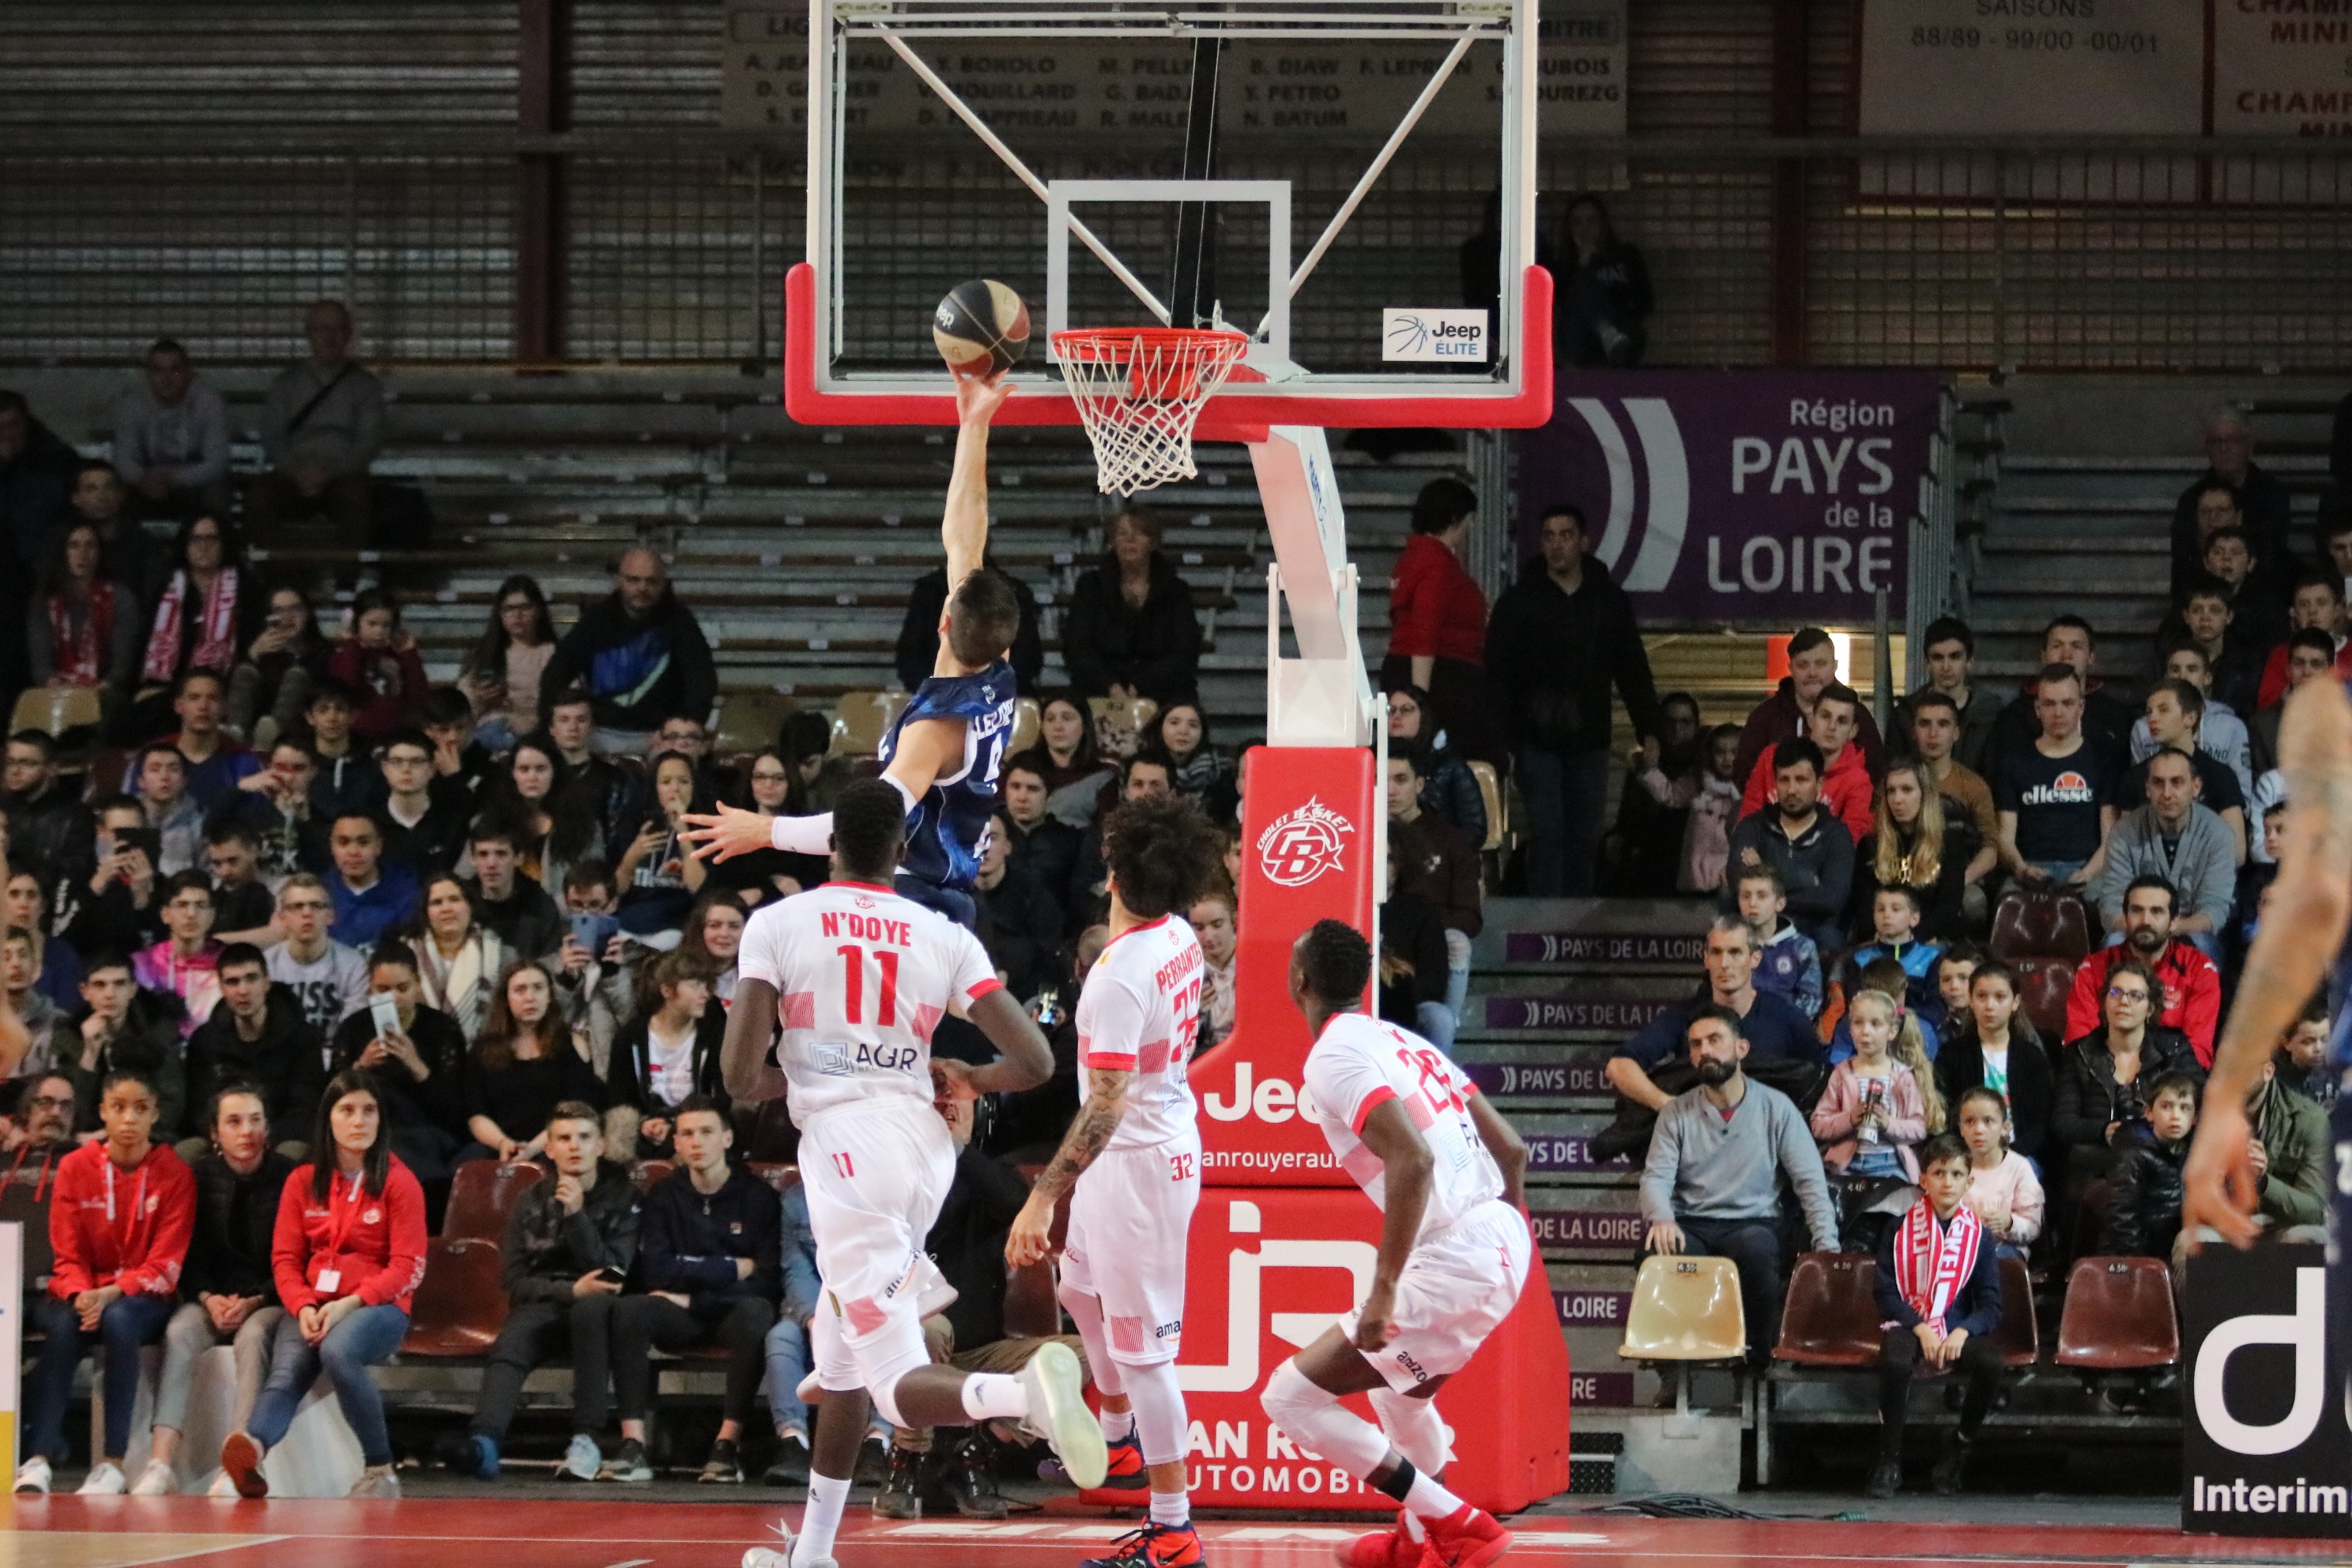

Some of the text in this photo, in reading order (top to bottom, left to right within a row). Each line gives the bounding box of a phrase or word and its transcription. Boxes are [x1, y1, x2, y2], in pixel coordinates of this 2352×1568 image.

[1432, 321, 1481, 341] Jeep
[1435, 340, 1478, 356] ÉLITE
[1790, 399, 1894, 432] Région
[1732, 437, 1894, 495] PAYS
[1825, 501, 1893, 528] de la
[1708, 536, 1893, 594] LOIRE
[2022, 784, 2094, 805] ellesse
[820, 911, 912, 948] N'DOYE
[1561, 938, 1606, 958] PAYS
[1609, 938, 1632, 958] DE
[1638, 938, 1658, 958] LA
[837, 944, 899, 1027] 11
[1544, 1004, 1589, 1024] PAYS
[1592, 1004, 1615, 1024] DE
[1620, 1004, 1642, 1024] LA
[1521, 1069, 1566, 1090] PAYS
[1570, 1069, 1593, 1089] DE
[1554, 1140, 1577, 1163] DE
[831, 1152, 855, 1178] 11
[1170, 1153, 1194, 1182] 32
[1560, 1218, 1583, 1240] LA
[1589, 1219, 1642, 1241] LOIRE
[1562, 1297, 1618, 1319] LOIRE
